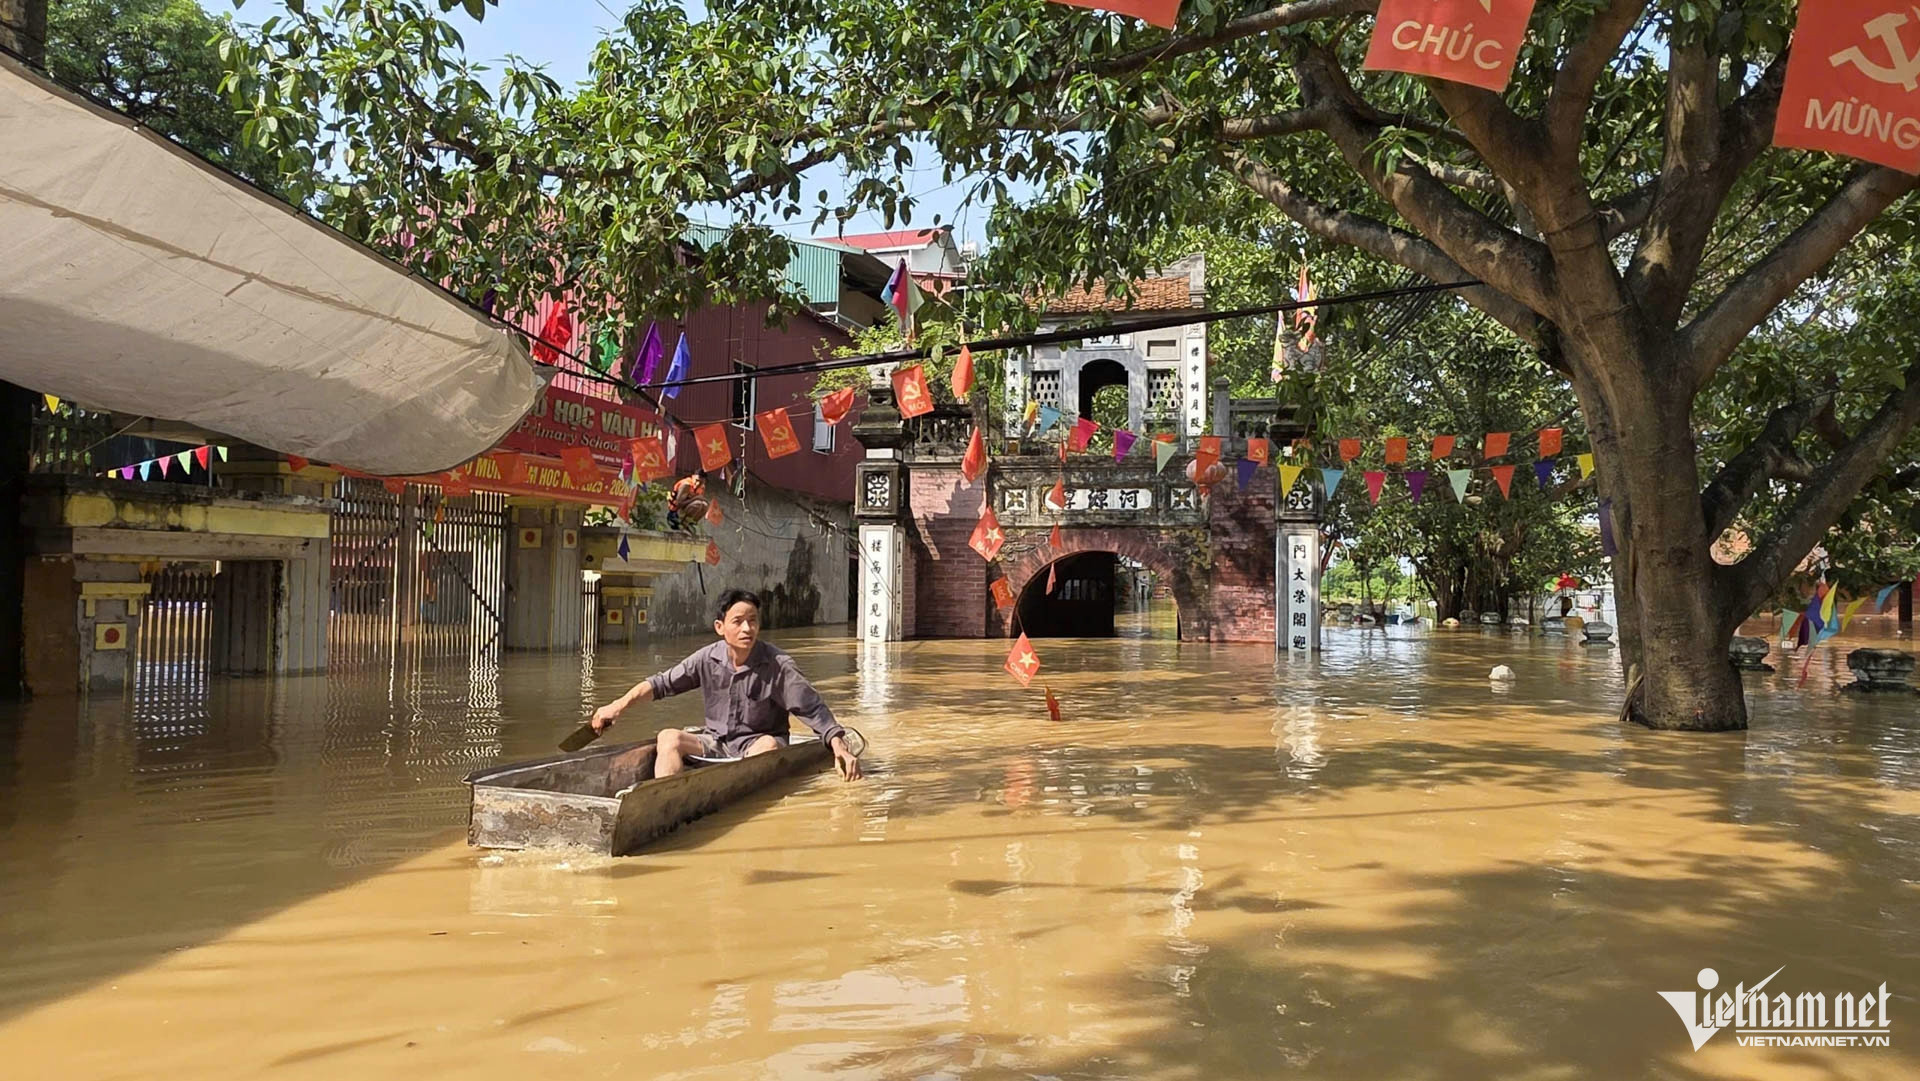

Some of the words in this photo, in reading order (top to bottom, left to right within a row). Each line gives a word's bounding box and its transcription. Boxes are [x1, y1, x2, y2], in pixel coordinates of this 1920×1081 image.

[1391, 20, 1502, 70] CHÚC
[1804, 97, 1920, 149] MỪNG
[553, 399, 595, 430] HỌC
[602, 411, 636, 438] VÂN
[538, 465, 561, 490] HỌC
